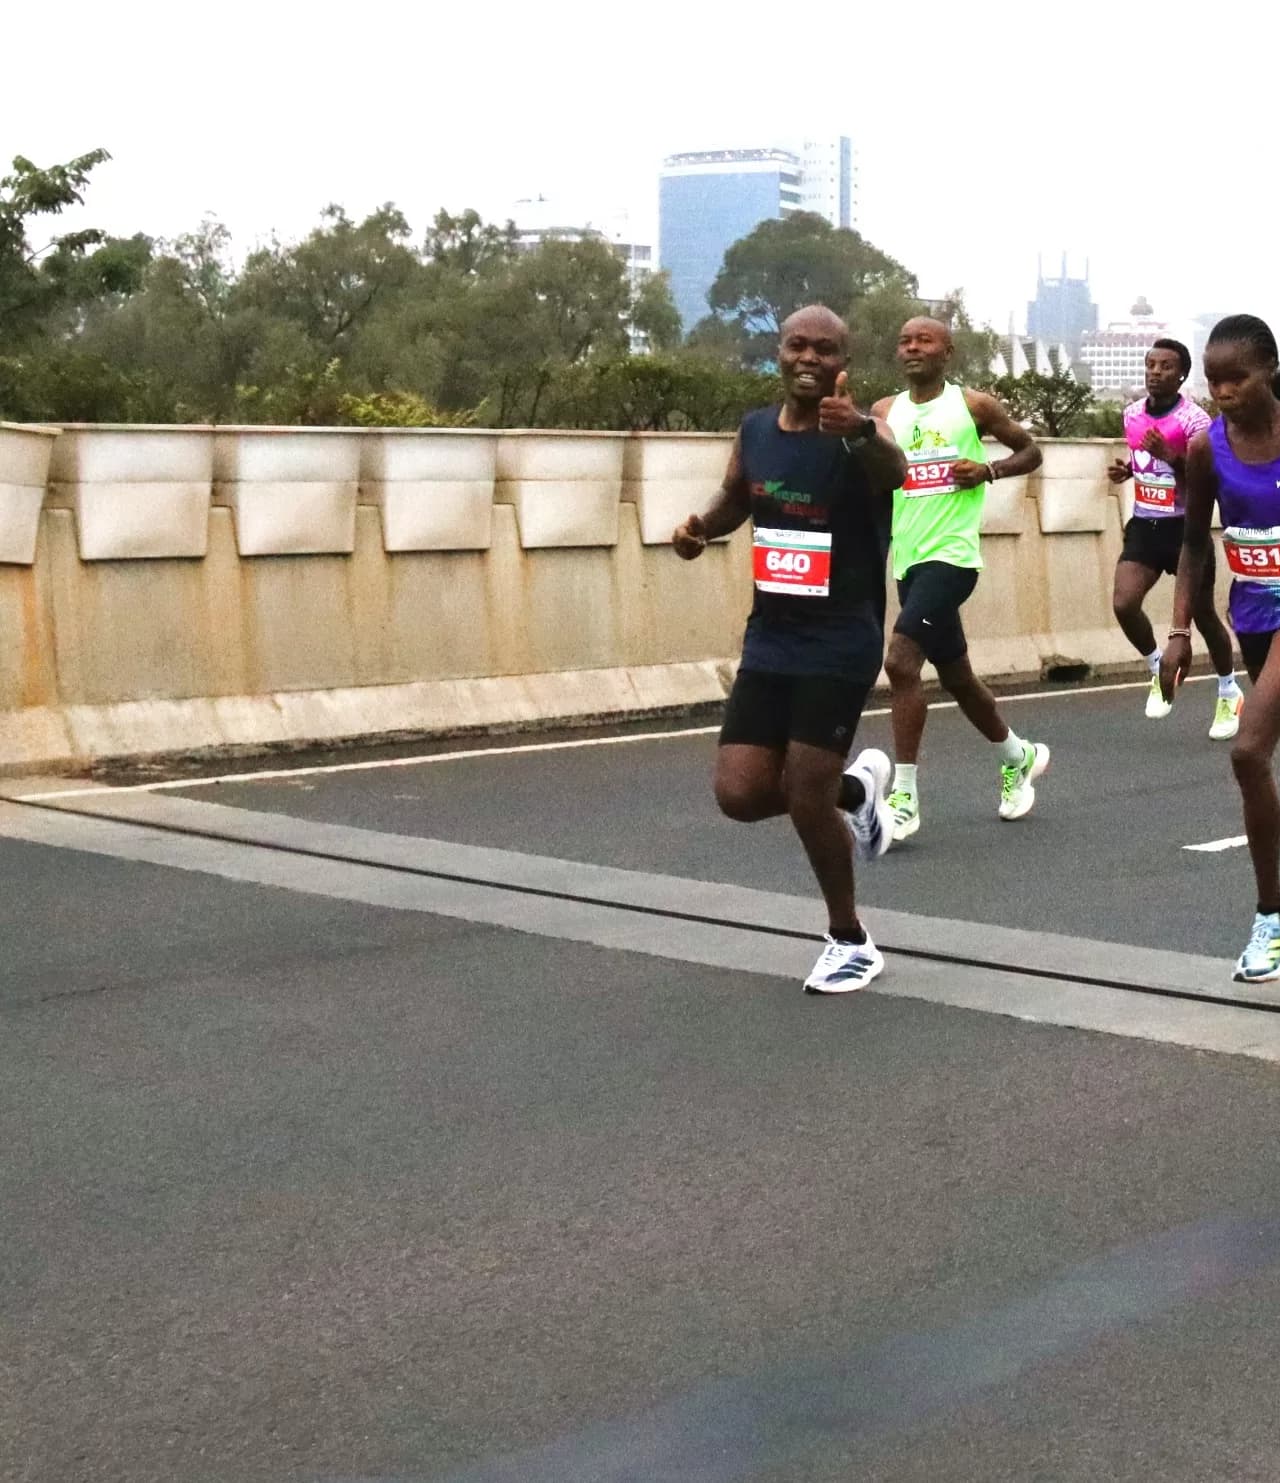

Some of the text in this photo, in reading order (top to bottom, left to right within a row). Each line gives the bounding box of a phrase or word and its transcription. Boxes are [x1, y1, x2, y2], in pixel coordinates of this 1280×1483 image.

[907, 463, 950, 481] 1337
[1139, 486, 1167, 500] 1178
[765, 550, 811, 574] 640
[1239, 547, 1280, 567] 531
